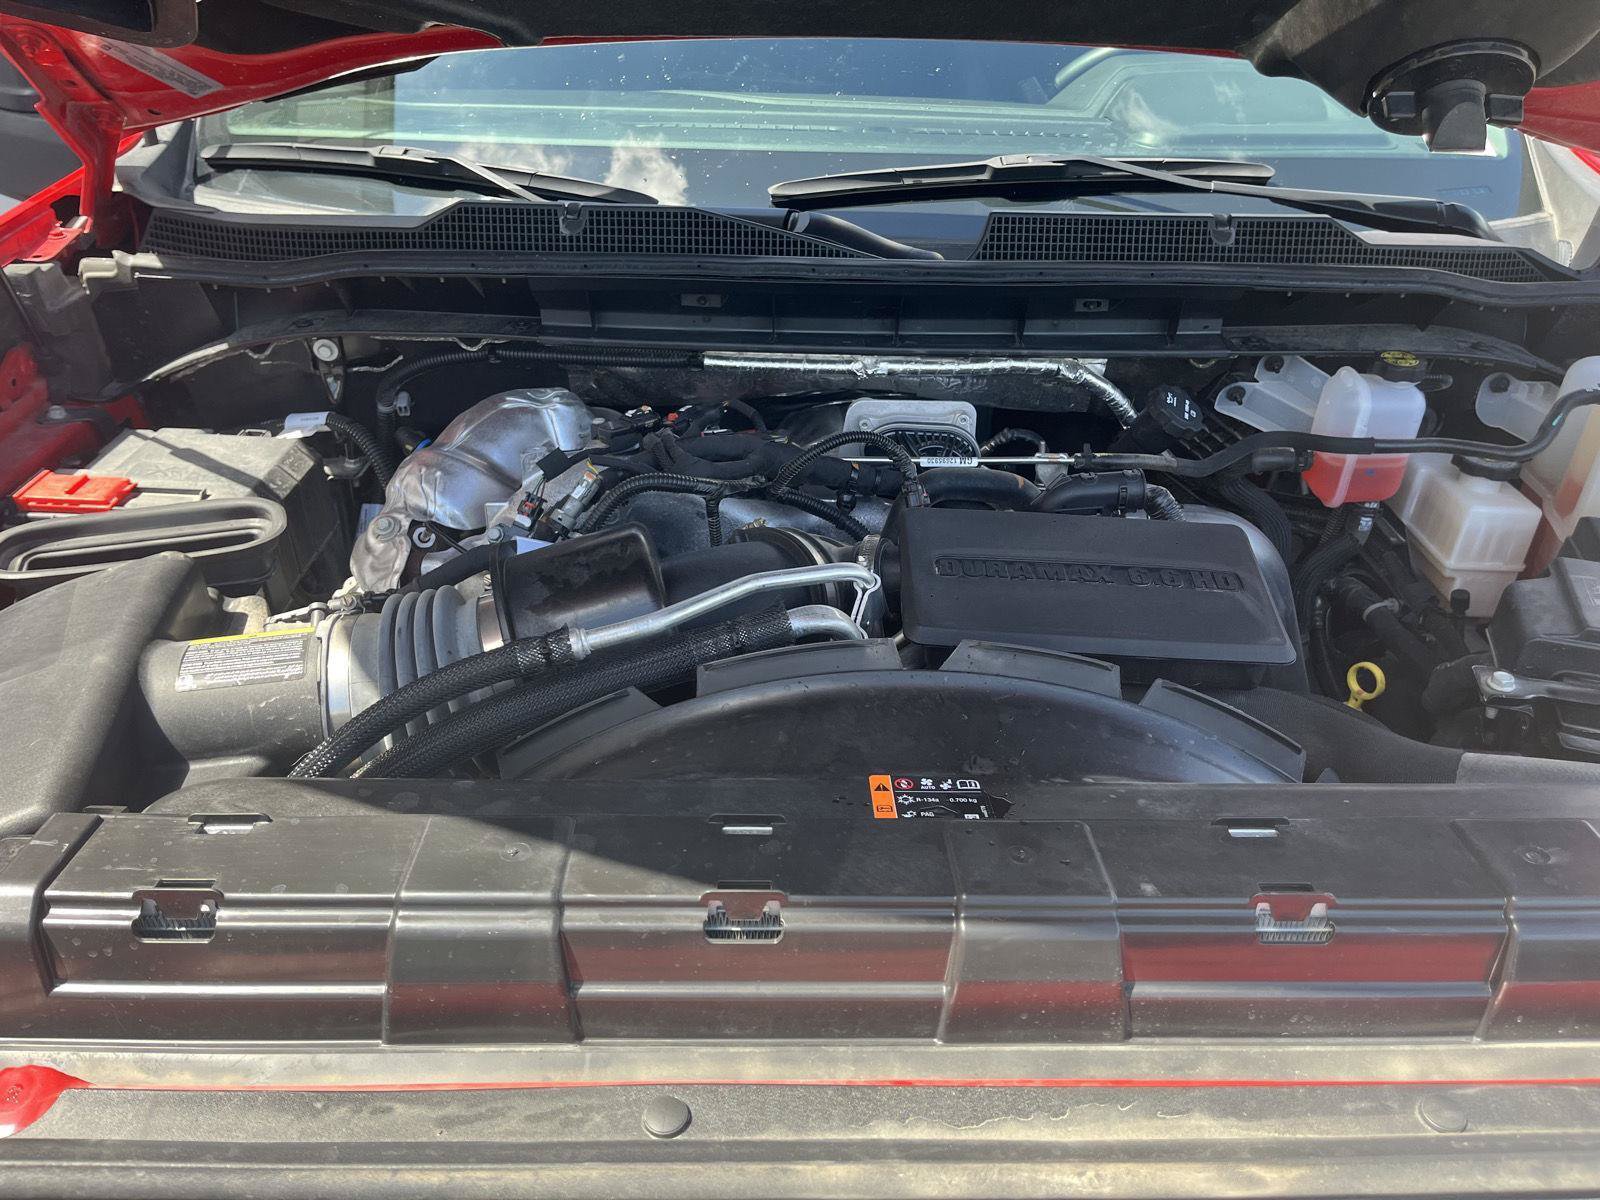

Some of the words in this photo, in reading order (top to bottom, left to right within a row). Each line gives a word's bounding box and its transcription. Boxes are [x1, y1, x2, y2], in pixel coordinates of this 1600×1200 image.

[960, 457, 973, 465] GM
[937, 558, 1115, 584] DURAMAX
[1127, 567, 1184, 587] 6.6
[1190, 571, 1244, 592] HD
